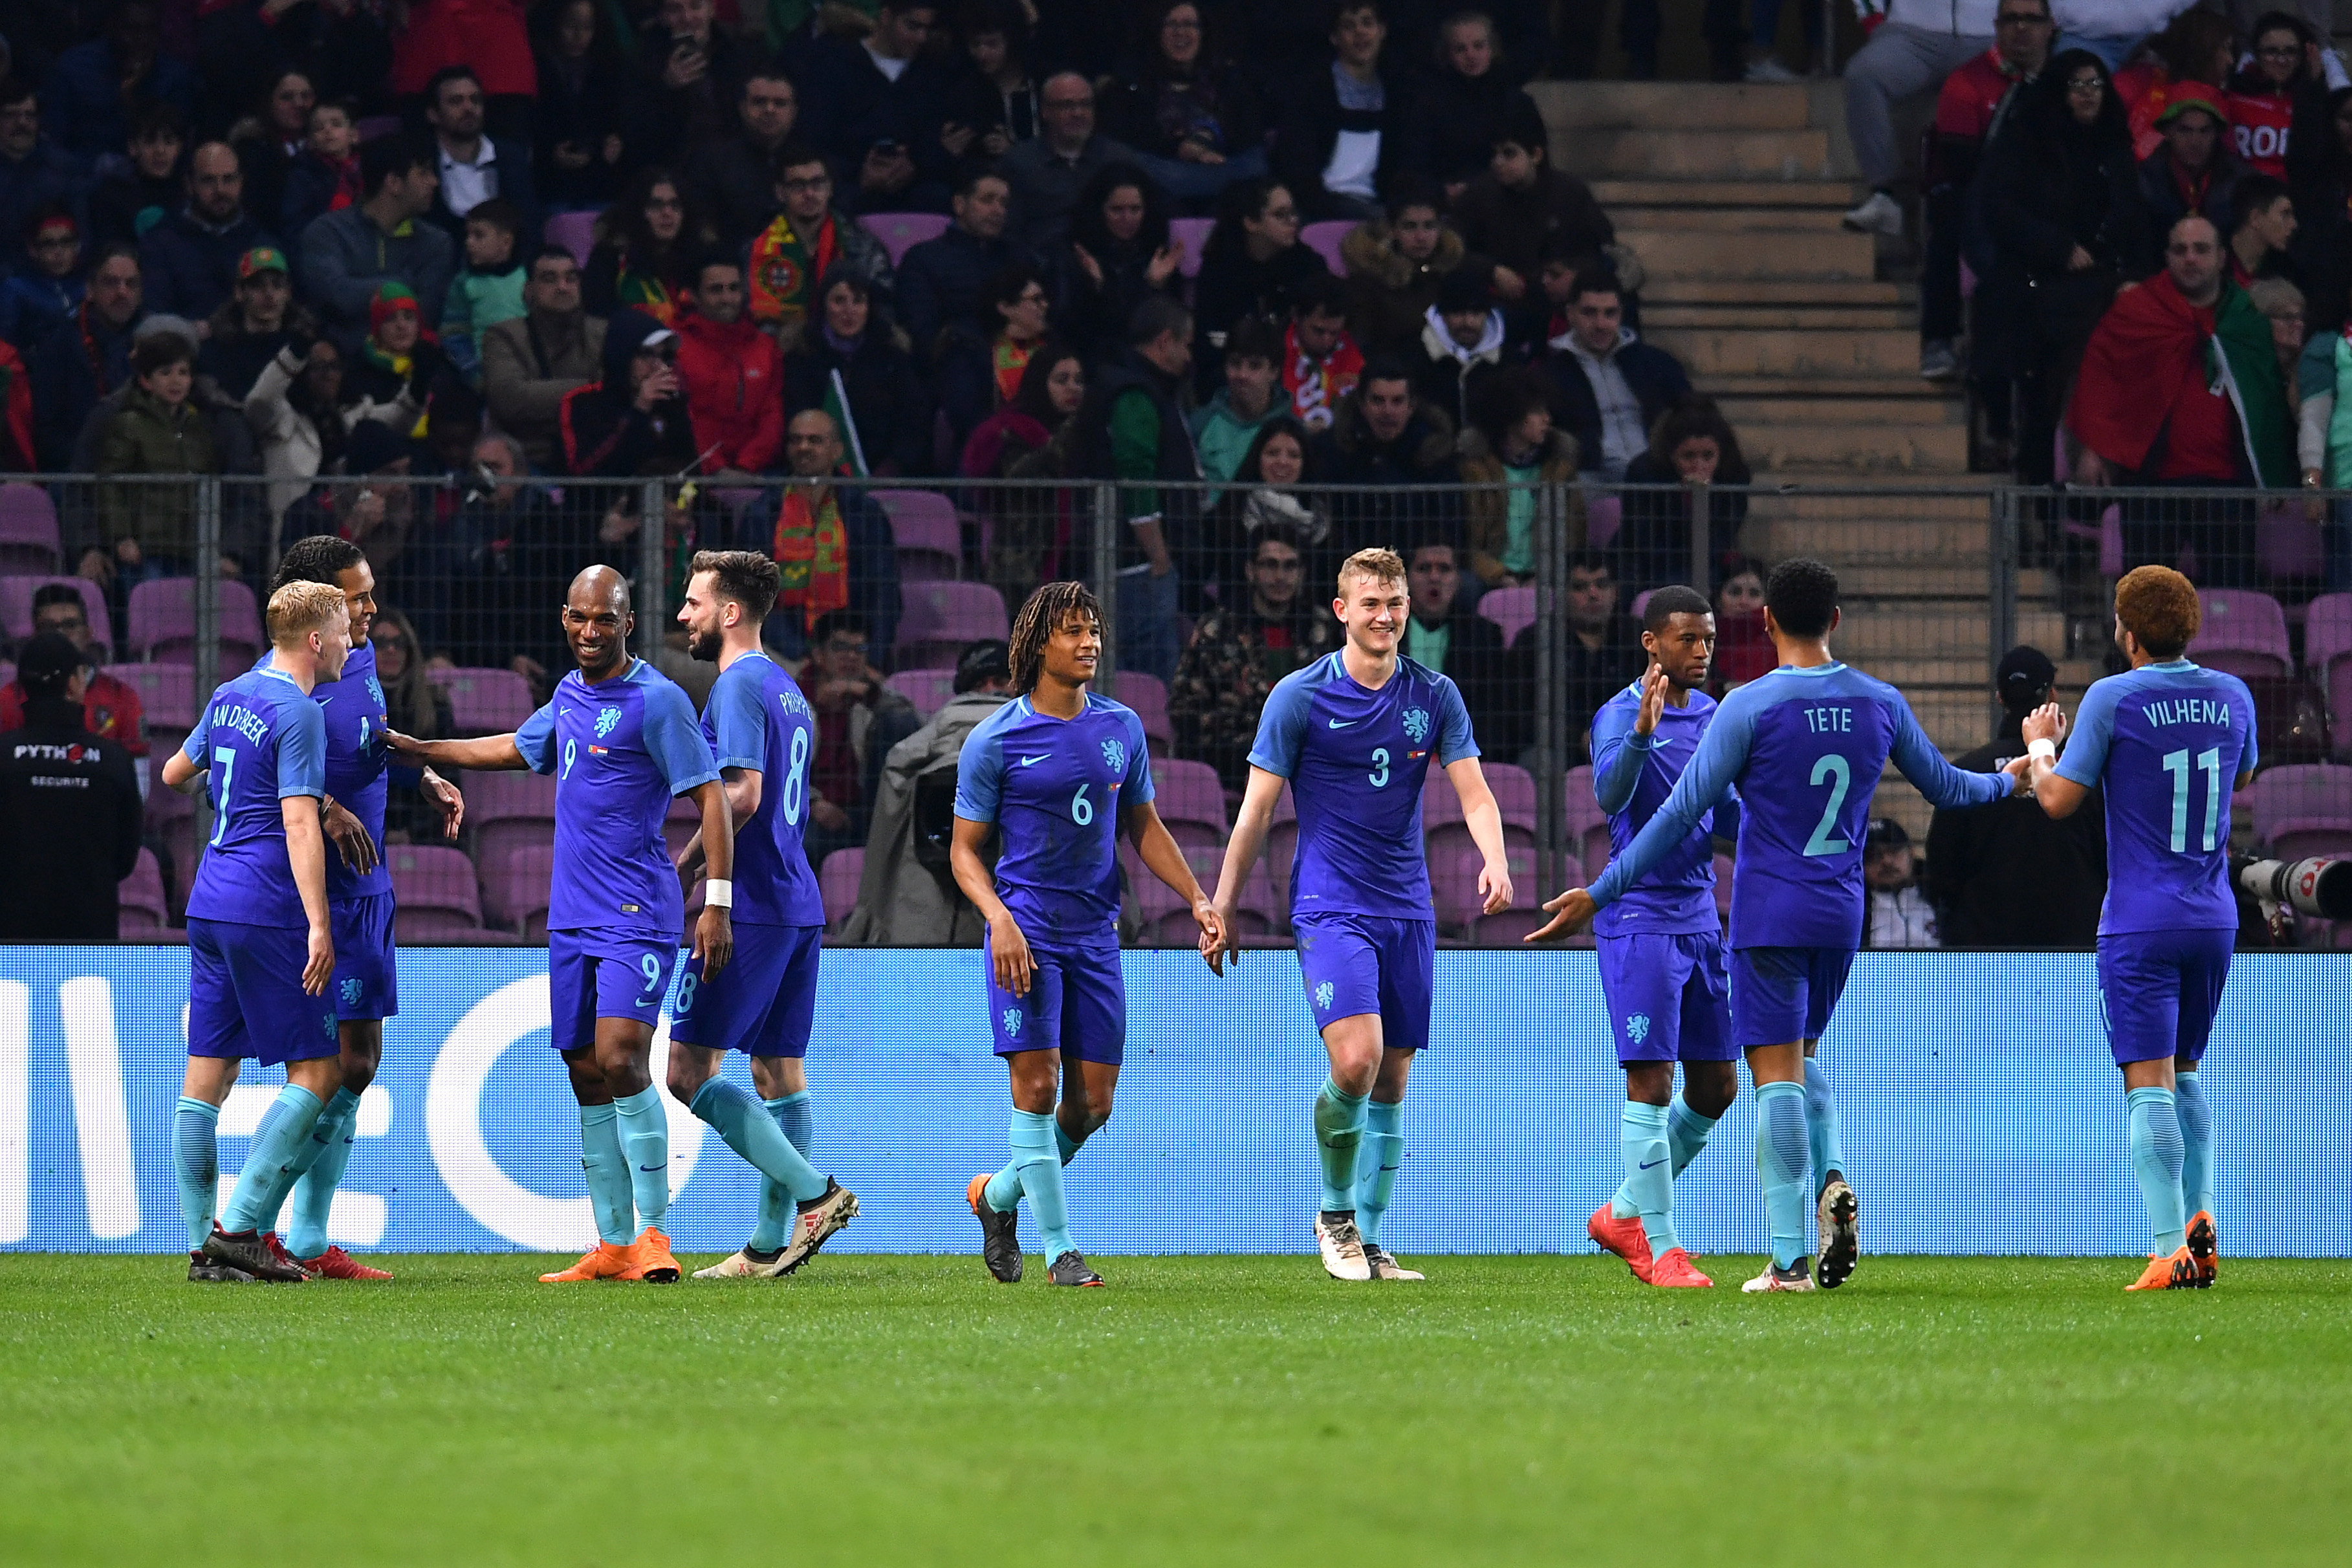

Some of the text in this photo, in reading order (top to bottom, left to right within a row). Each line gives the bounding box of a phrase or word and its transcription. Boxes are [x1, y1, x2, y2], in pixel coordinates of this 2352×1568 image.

[1803, 707, 1851, 734] TETE
[2142, 699, 2230, 728] VILHENA
[359, 716, 371, 758] 4
[561, 738, 576, 781] 9
[783, 726, 808, 826] 8
[1368, 747, 1389, 787] 3
[210, 746, 237, 846] 7
[1071, 783, 1093, 826] 6
[1802, 754, 1851, 857] 2
[2162, 746, 2219, 853] 11
[641, 953, 660, 992] 9
[676, 972, 698, 1014] 8
